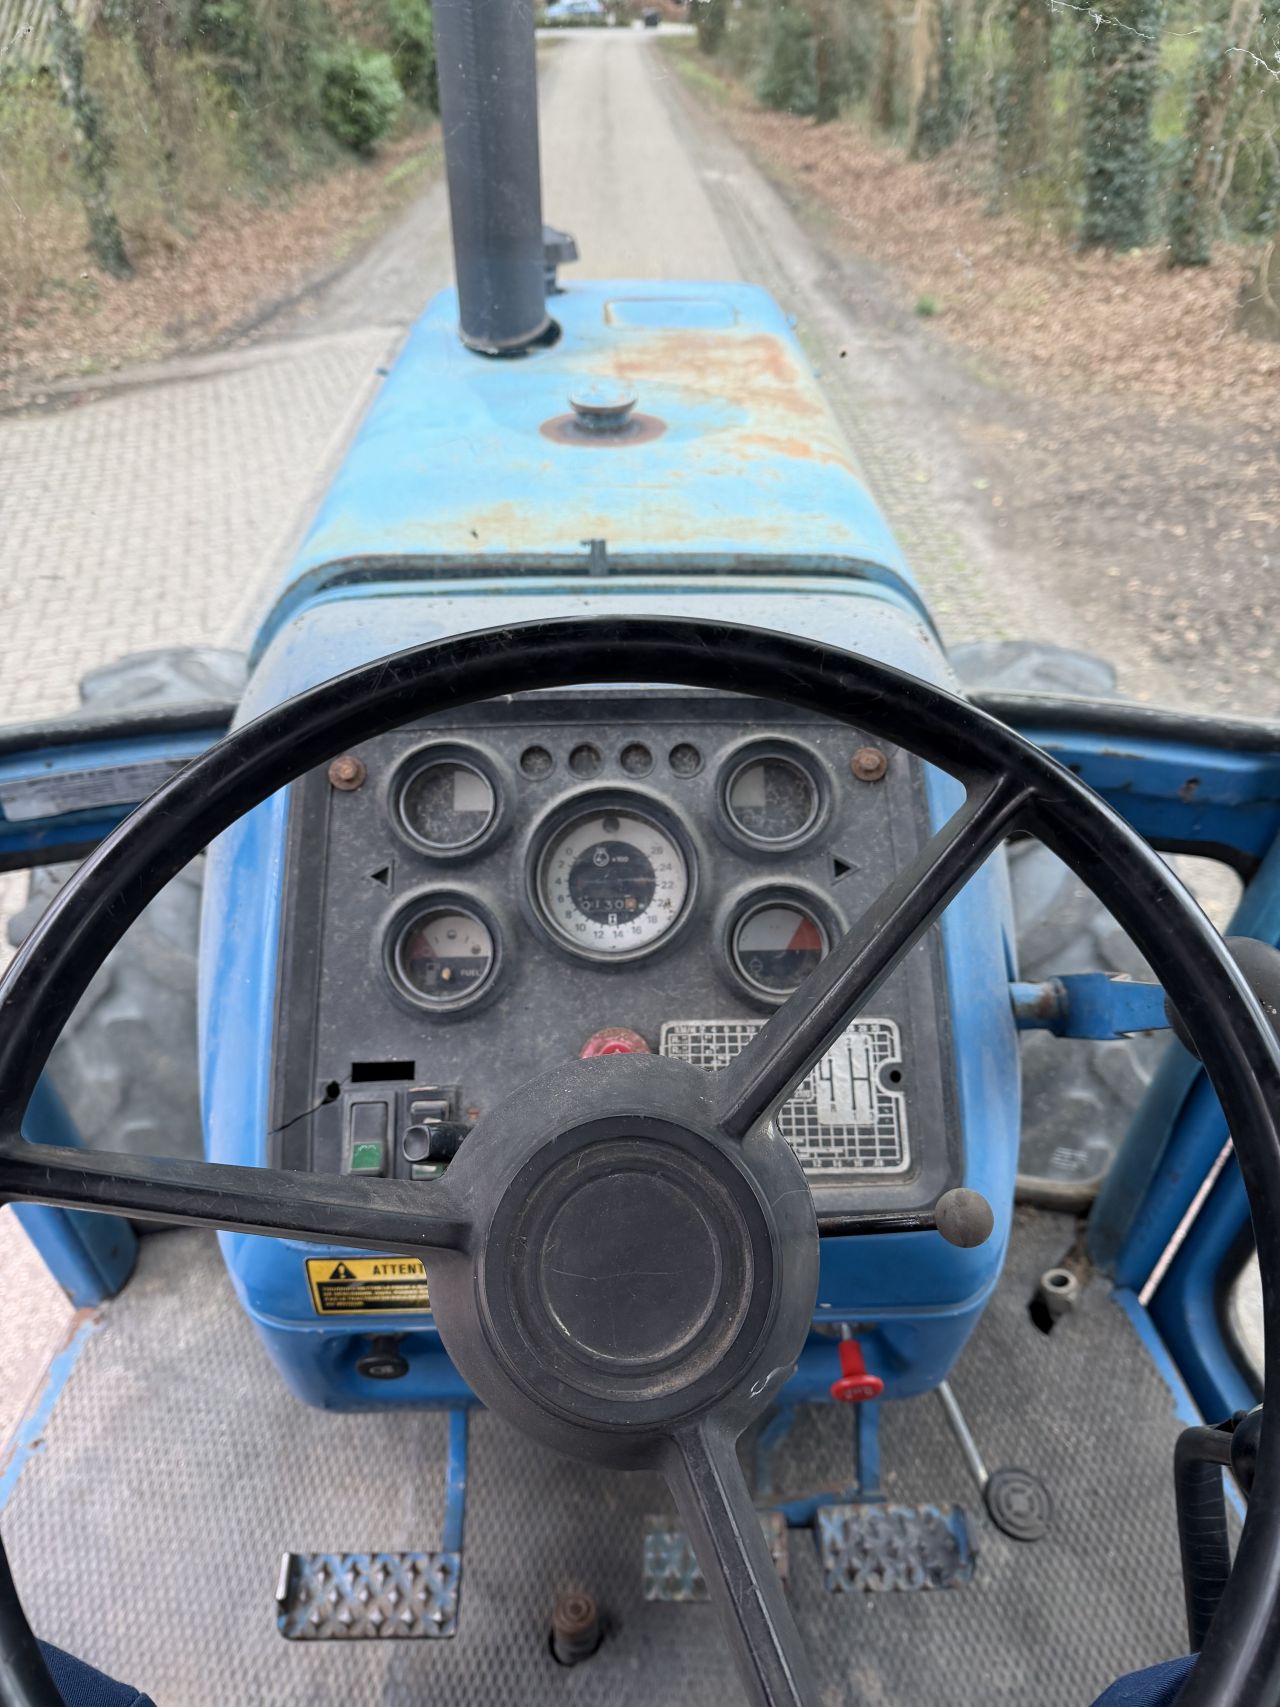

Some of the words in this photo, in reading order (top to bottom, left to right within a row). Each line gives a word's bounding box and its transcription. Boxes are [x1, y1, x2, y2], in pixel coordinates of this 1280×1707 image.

[659, 863, 673, 872] 24
[660, 881, 674, 890] 22
[646, 915, 659, 925] 18
[575, 923, 586, 932] 10
[631, 925, 643, 935] 16
[593, 929, 605, 939] 12
[612, 929, 625, 939] 14
[460, 968, 481, 977] FUEL
